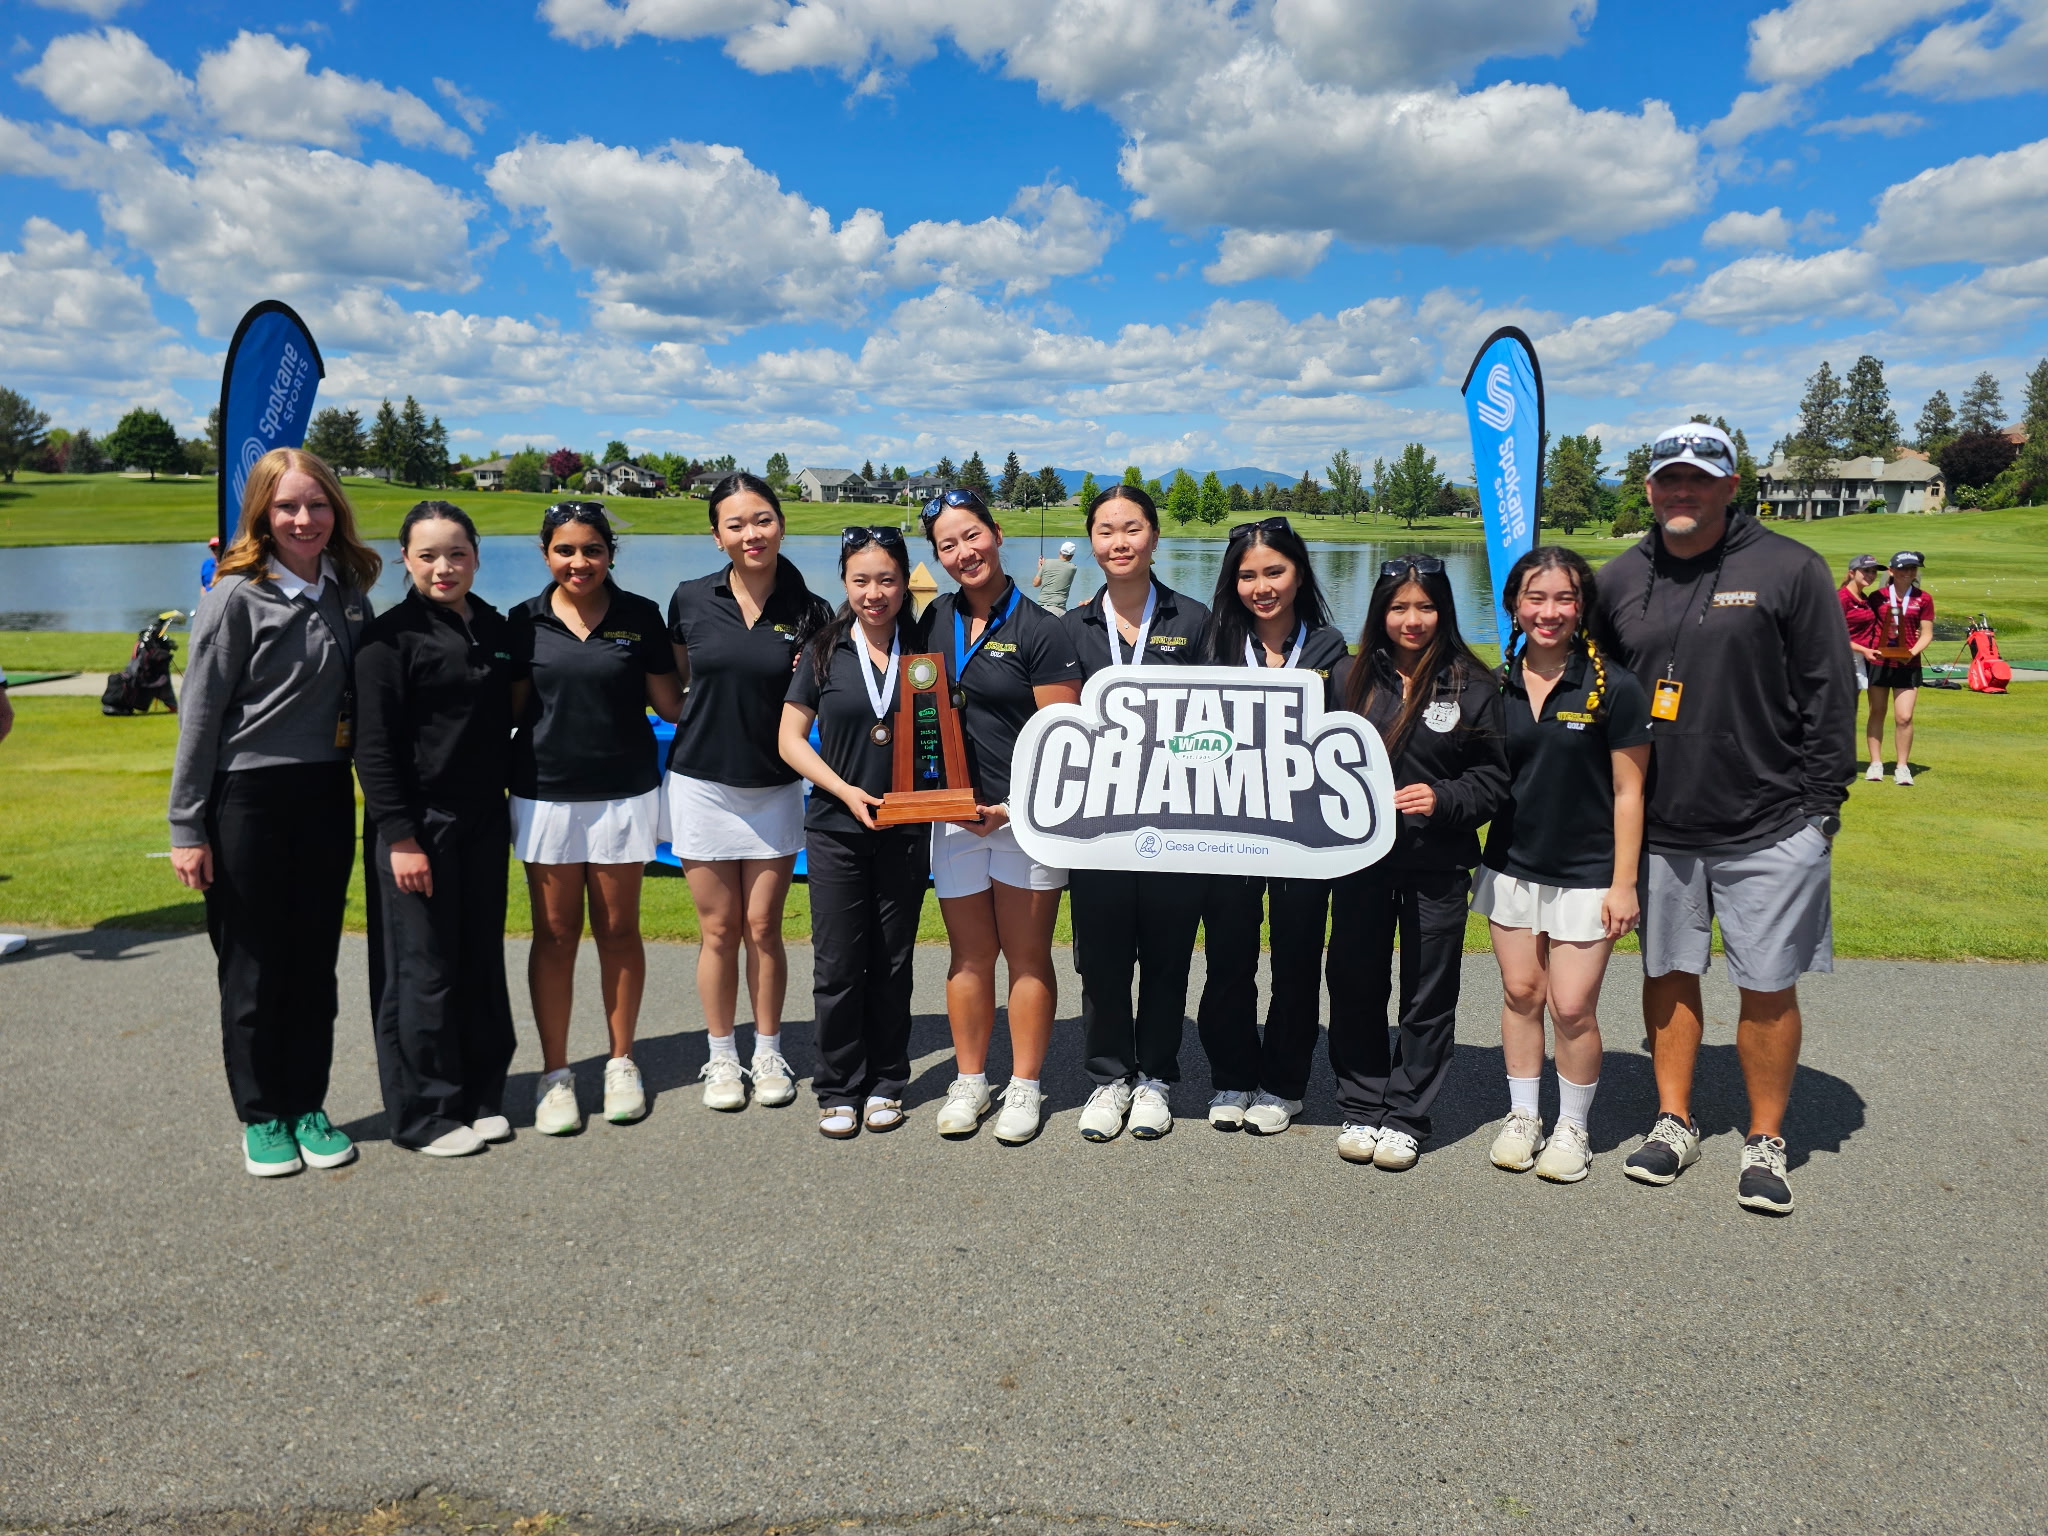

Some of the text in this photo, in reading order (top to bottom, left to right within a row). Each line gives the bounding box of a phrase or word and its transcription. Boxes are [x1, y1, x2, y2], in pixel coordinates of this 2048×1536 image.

[259, 342, 299, 439] Spokane
[283, 357, 309, 424] SPORTS
[1494, 477, 1512, 548] SPORTS
[1498, 436, 1527, 540] Spokane
[616, 638, 631, 646] GOLF
[1105, 686, 1298, 748] STATE
[1178, 738, 1222, 752] WIAA
[1566, 721, 1586, 731] GOLF
[1033, 725, 1373, 839] CHAMPS
[1165, 840, 1269, 855] Gesa Credit Union
